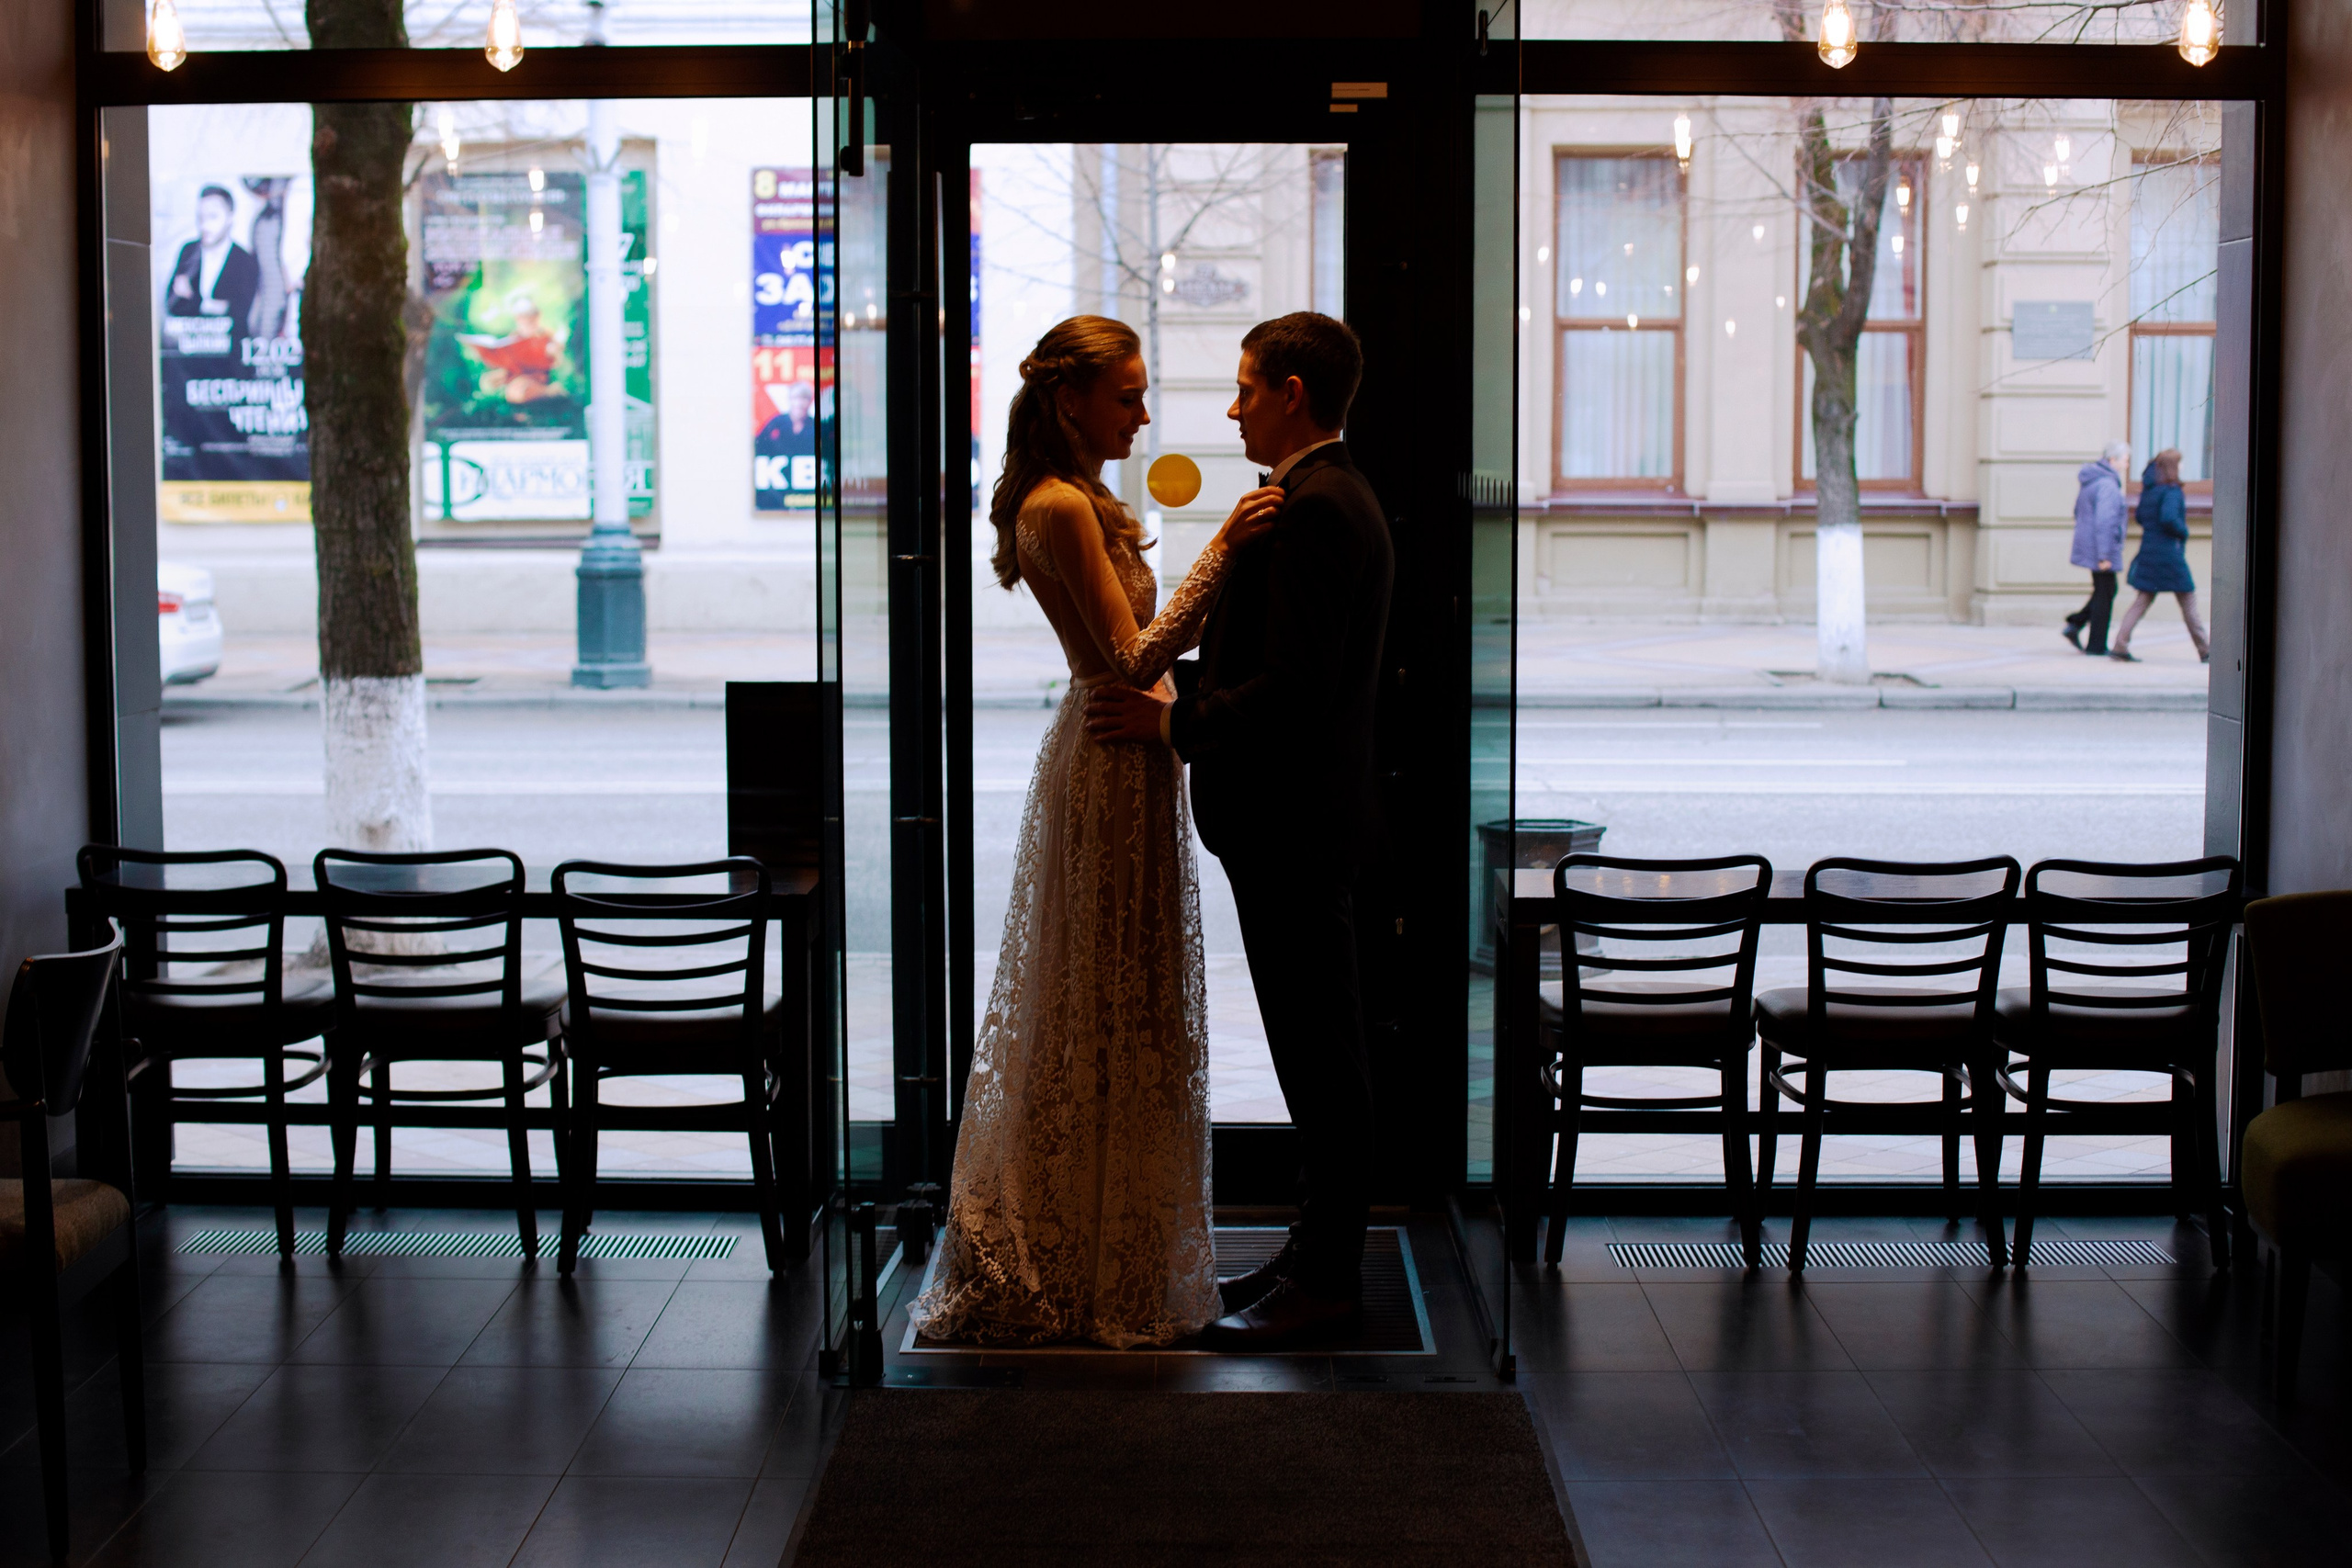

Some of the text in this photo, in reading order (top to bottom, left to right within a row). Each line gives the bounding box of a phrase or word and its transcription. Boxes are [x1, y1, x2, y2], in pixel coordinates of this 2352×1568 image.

[754, 169, 777, 199] 8
[753, 349, 794, 381] 11
[754, 454, 830, 491] КВ
